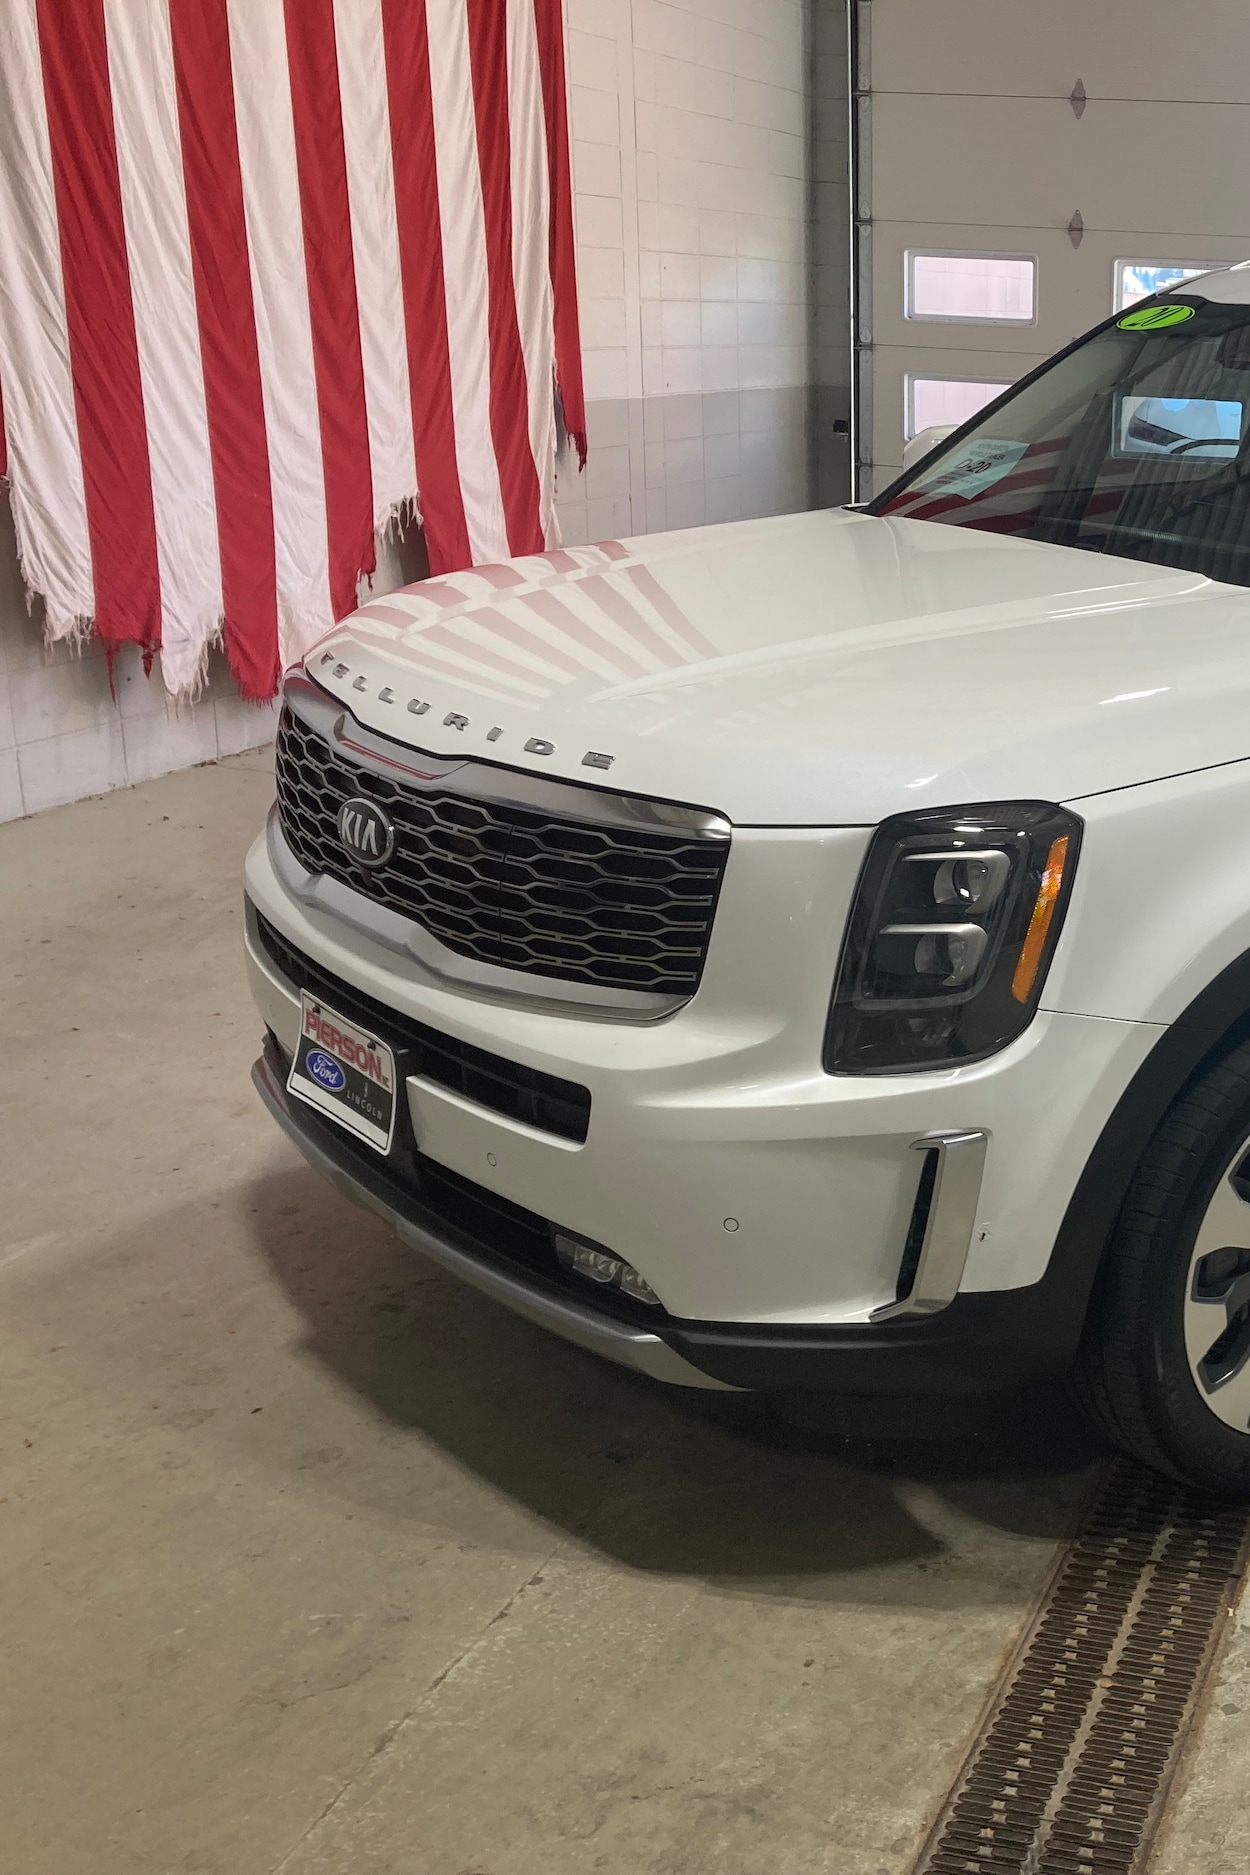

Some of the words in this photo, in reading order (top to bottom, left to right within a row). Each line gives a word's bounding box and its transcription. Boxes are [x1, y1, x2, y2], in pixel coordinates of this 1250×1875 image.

[1124, 307, 1185, 327] 20
[320, 651, 616, 770] TELLURIDE
[341, 807, 379, 856] KIA
[304, 1008, 382, 1083] PIERSON
[313, 1054, 339, 1085] Ford
[346, 1089, 383, 1121] LINCOLN
